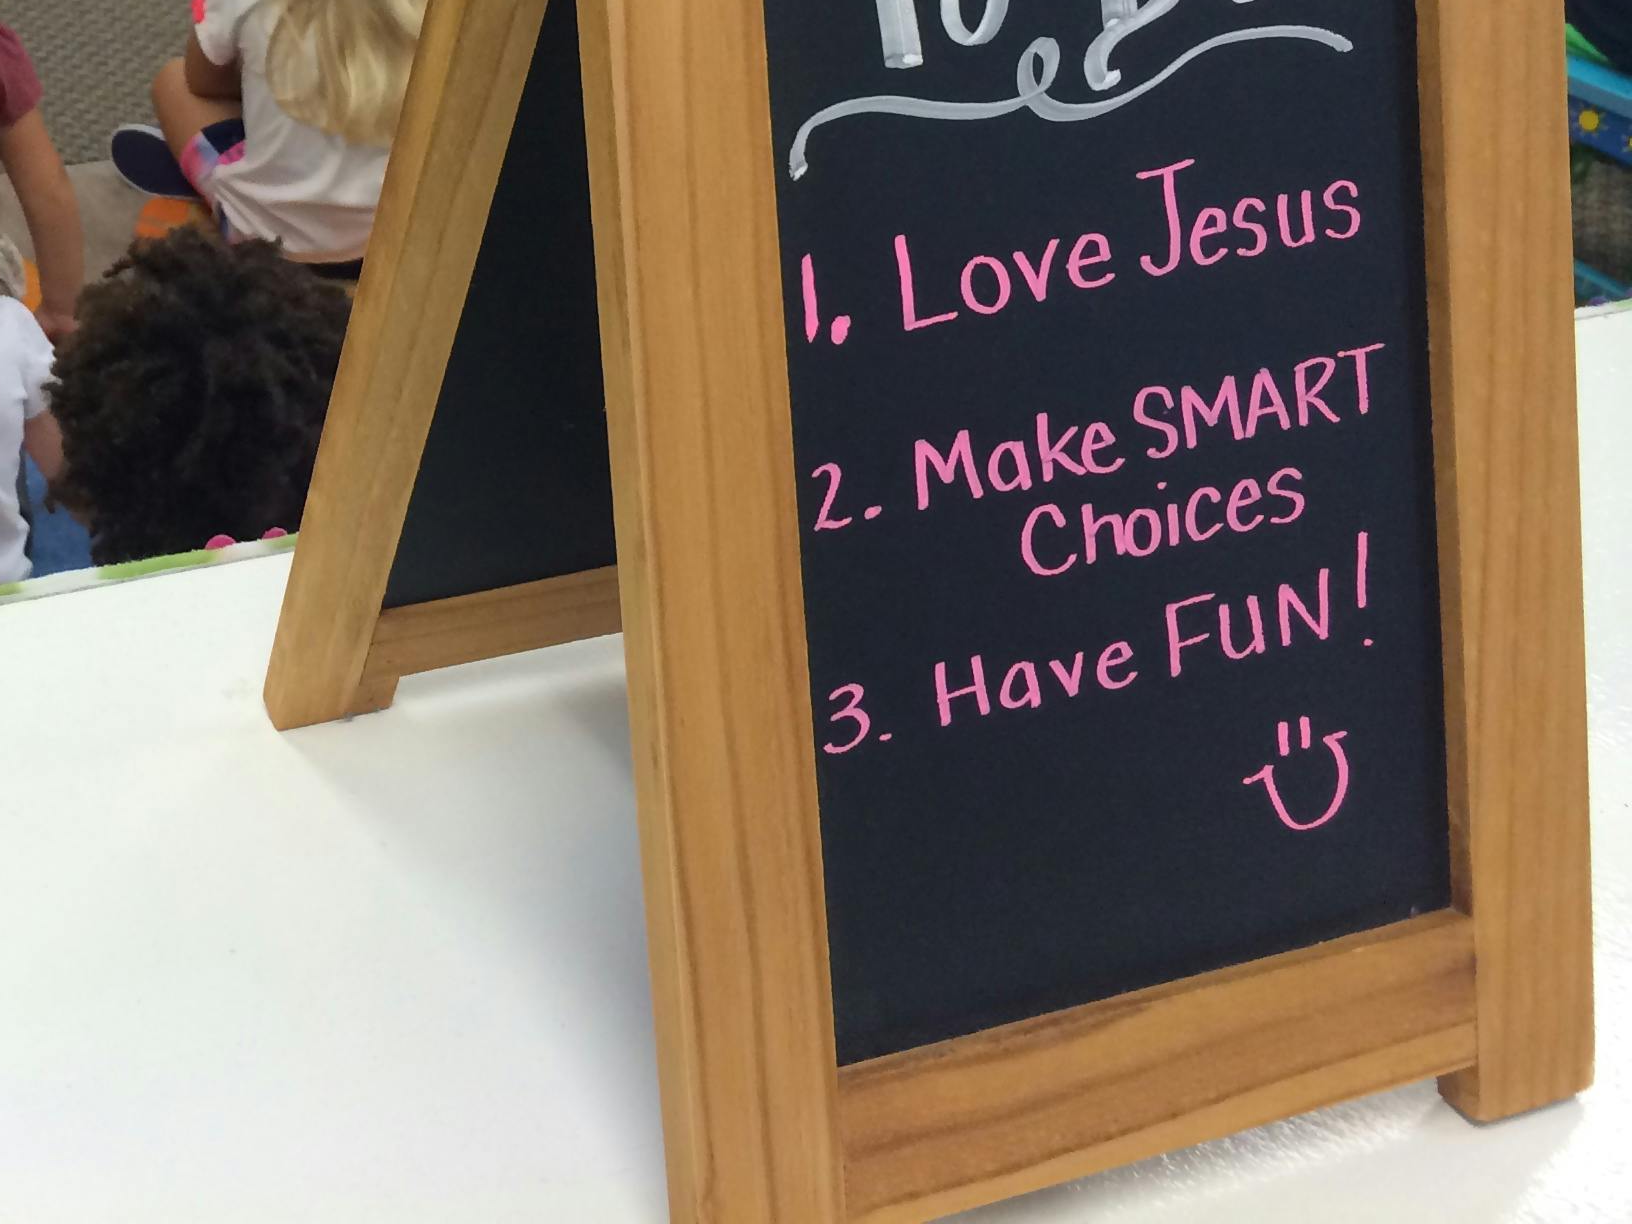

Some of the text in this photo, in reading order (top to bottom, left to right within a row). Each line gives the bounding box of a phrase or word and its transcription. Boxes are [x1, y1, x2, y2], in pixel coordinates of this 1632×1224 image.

[800, 158, 1362, 346] 1. Love Jesus
[811, 342, 1386, 532] 2. Make SMART
[1020, 466, 1307, 577] Choices
[823, 683, 893, 755] 3.
[934, 640, 1138, 727] Have
